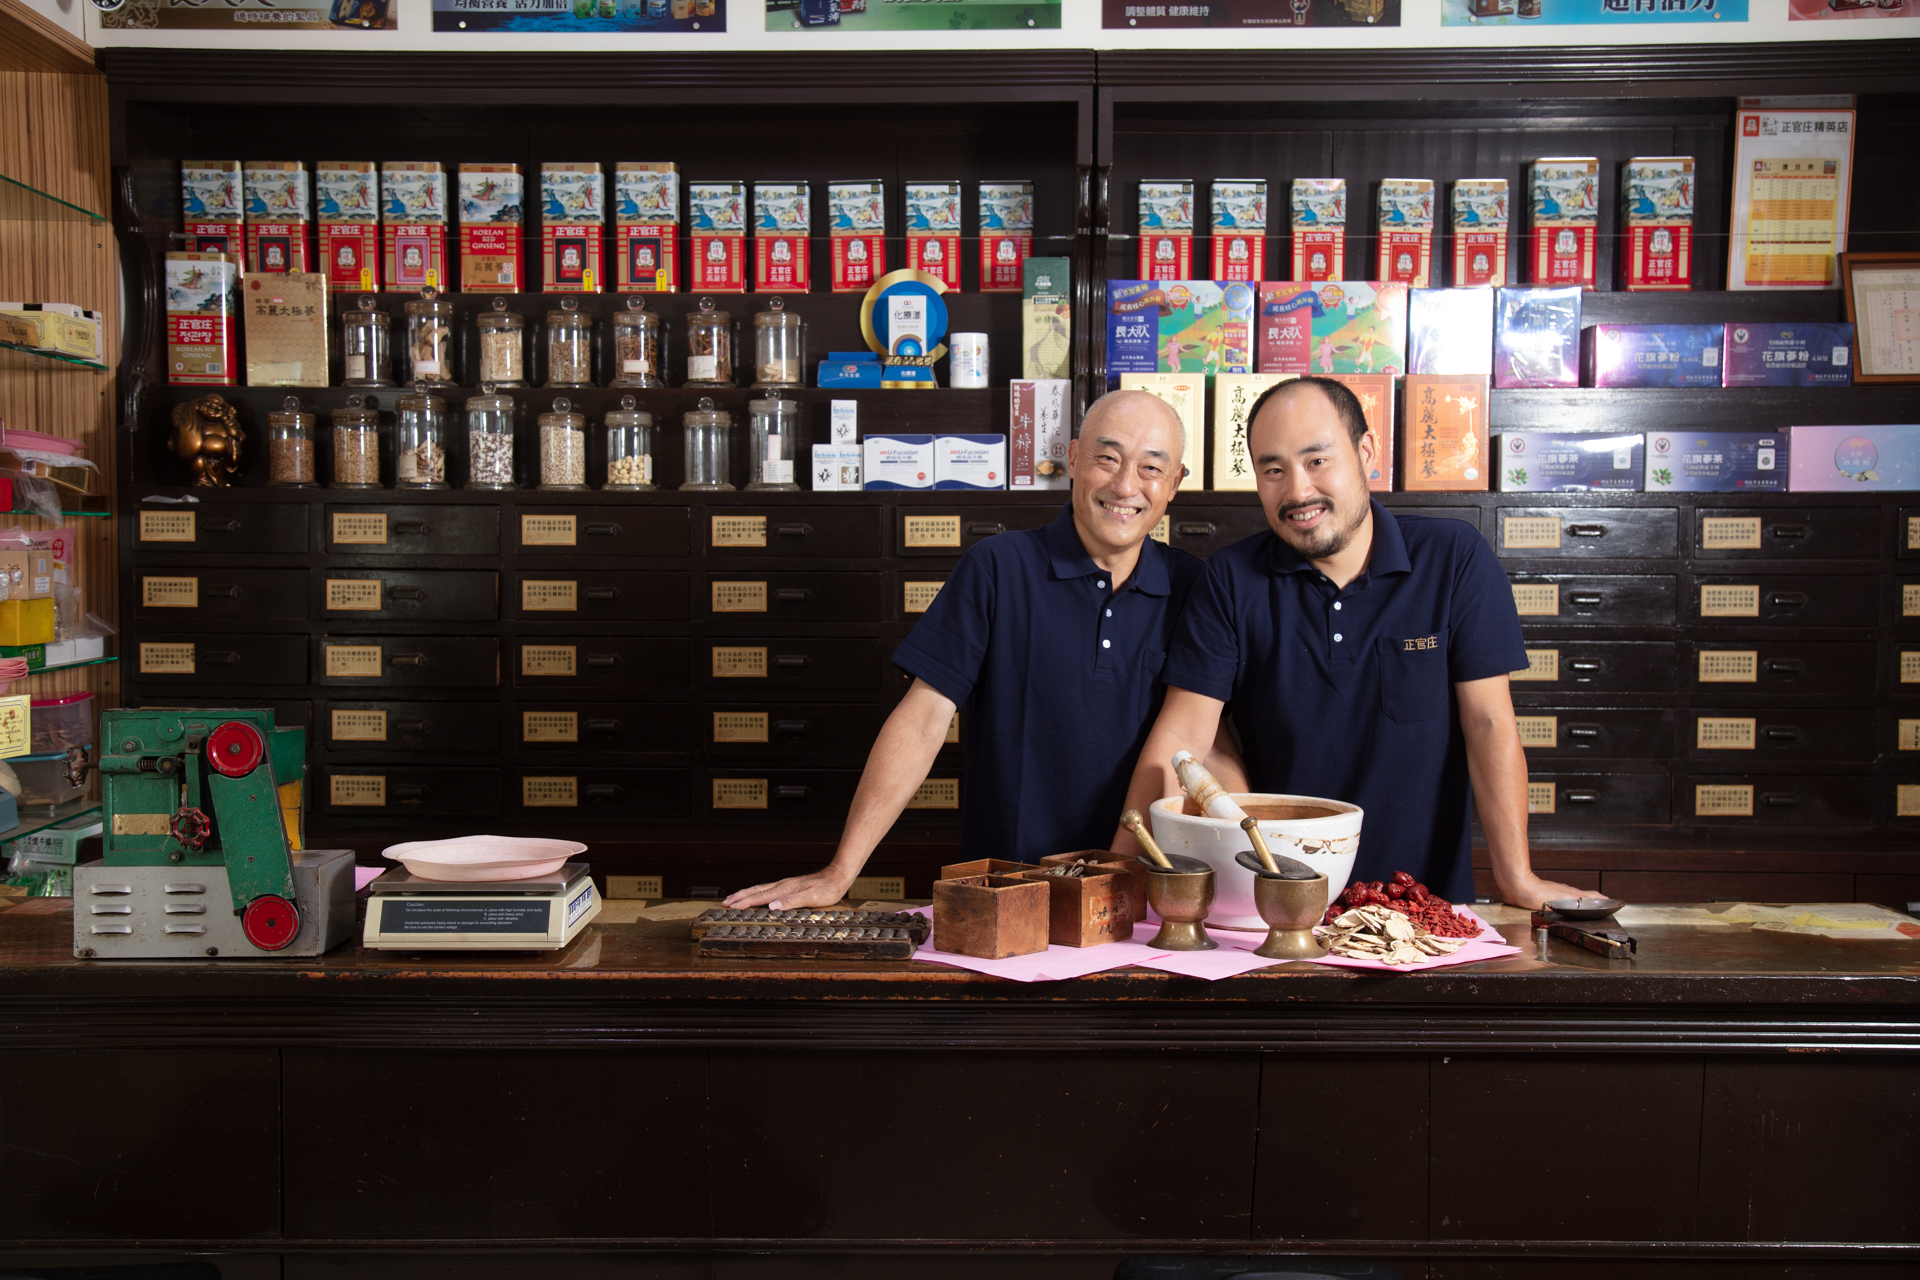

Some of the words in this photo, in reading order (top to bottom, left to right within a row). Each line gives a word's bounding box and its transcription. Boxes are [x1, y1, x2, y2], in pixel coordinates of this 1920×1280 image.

[1125, 6, 1167, 17] 調整體質
[1168, 5, 1210, 17] 健康維持
[1781, 121, 1849, 133] 正官庄精英店
[196, 224, 227, 235] 正官庄
[258, 225, 289, 235] 正官庄
[330, 225, 361, 236] 正官庄
[397, 225, 428, 236] 正官庄
[555, 226, 585, 236] 正官庄
[629, 226, 660, 236] 正官庄
[1305, 233, 1333, 242] 正官庄
[1392, 234, 1421, 243] 正官庄
[1467, 234, 1496, 243] 正官庄
[472, 242, 506, 250] GINSENG
[1554, 259, 1578, 268] 正官庄
[1649, 259, 1673, 268] 正官庄
[706, 266, 728, 275] 正官庄
[770, 266, 792, 275] 正官庄
[847, 265, 869, 274] 正官庄
[922, 266, 944, 275] 正官庄
[995, 266, 1018, 274] 正官庄
[1154, 264, 1176, 273] 正官庄
[1227, 264, 1249, 273] 正官庄
[894, 310, 921, 320] 化療漾
[179, 319, 213, 330] 正官庄
[179, 331, 213, 343] 정관장
[1013, 384, 1021, 417] 媽媽的寶貝
[1403, 636, 1439, 651] 正官庄
